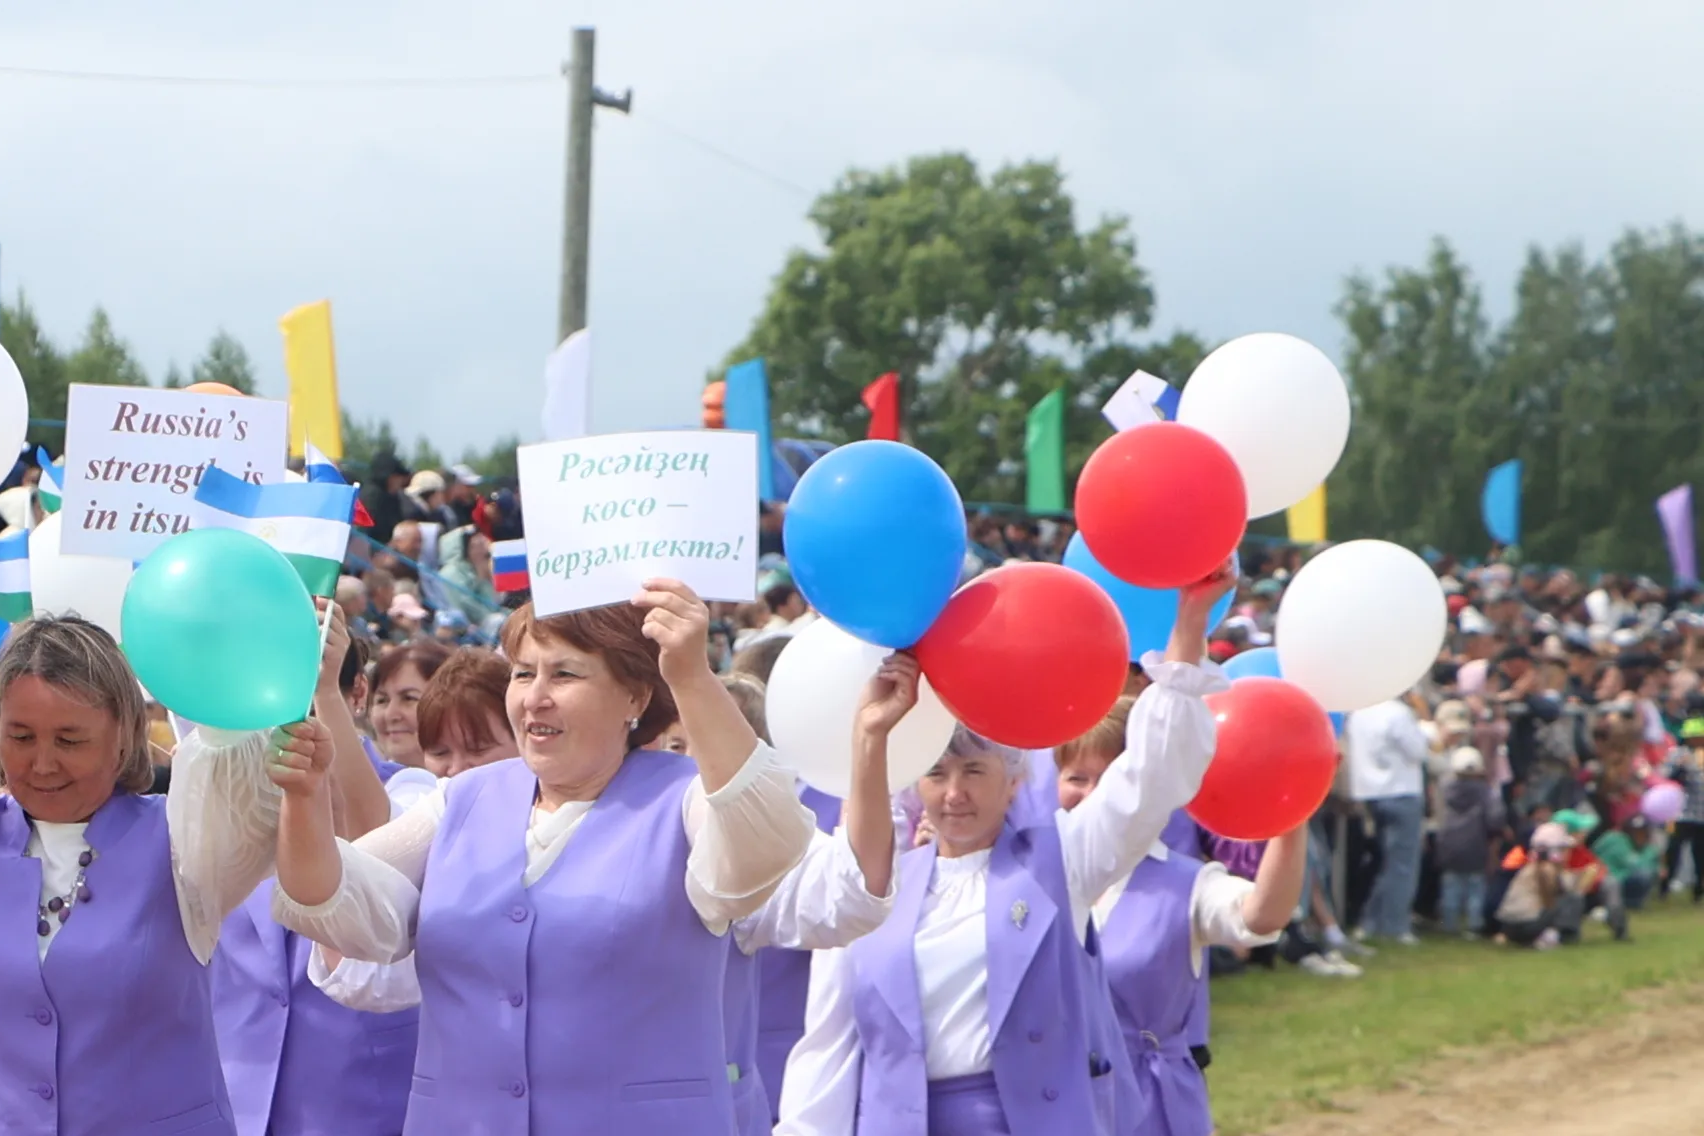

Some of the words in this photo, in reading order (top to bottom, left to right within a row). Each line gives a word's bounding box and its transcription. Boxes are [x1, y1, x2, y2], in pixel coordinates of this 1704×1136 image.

[110, 401, 248, 441] Russia’s
[84, 456, 216, 495] strengt
[558, 445, 710, 483] Рәсәйҙең
[82, 499, 118, 531] in
[582, 496, 656, 524] көсө
[535, 535, 745, 579] берҙәмлектә!
